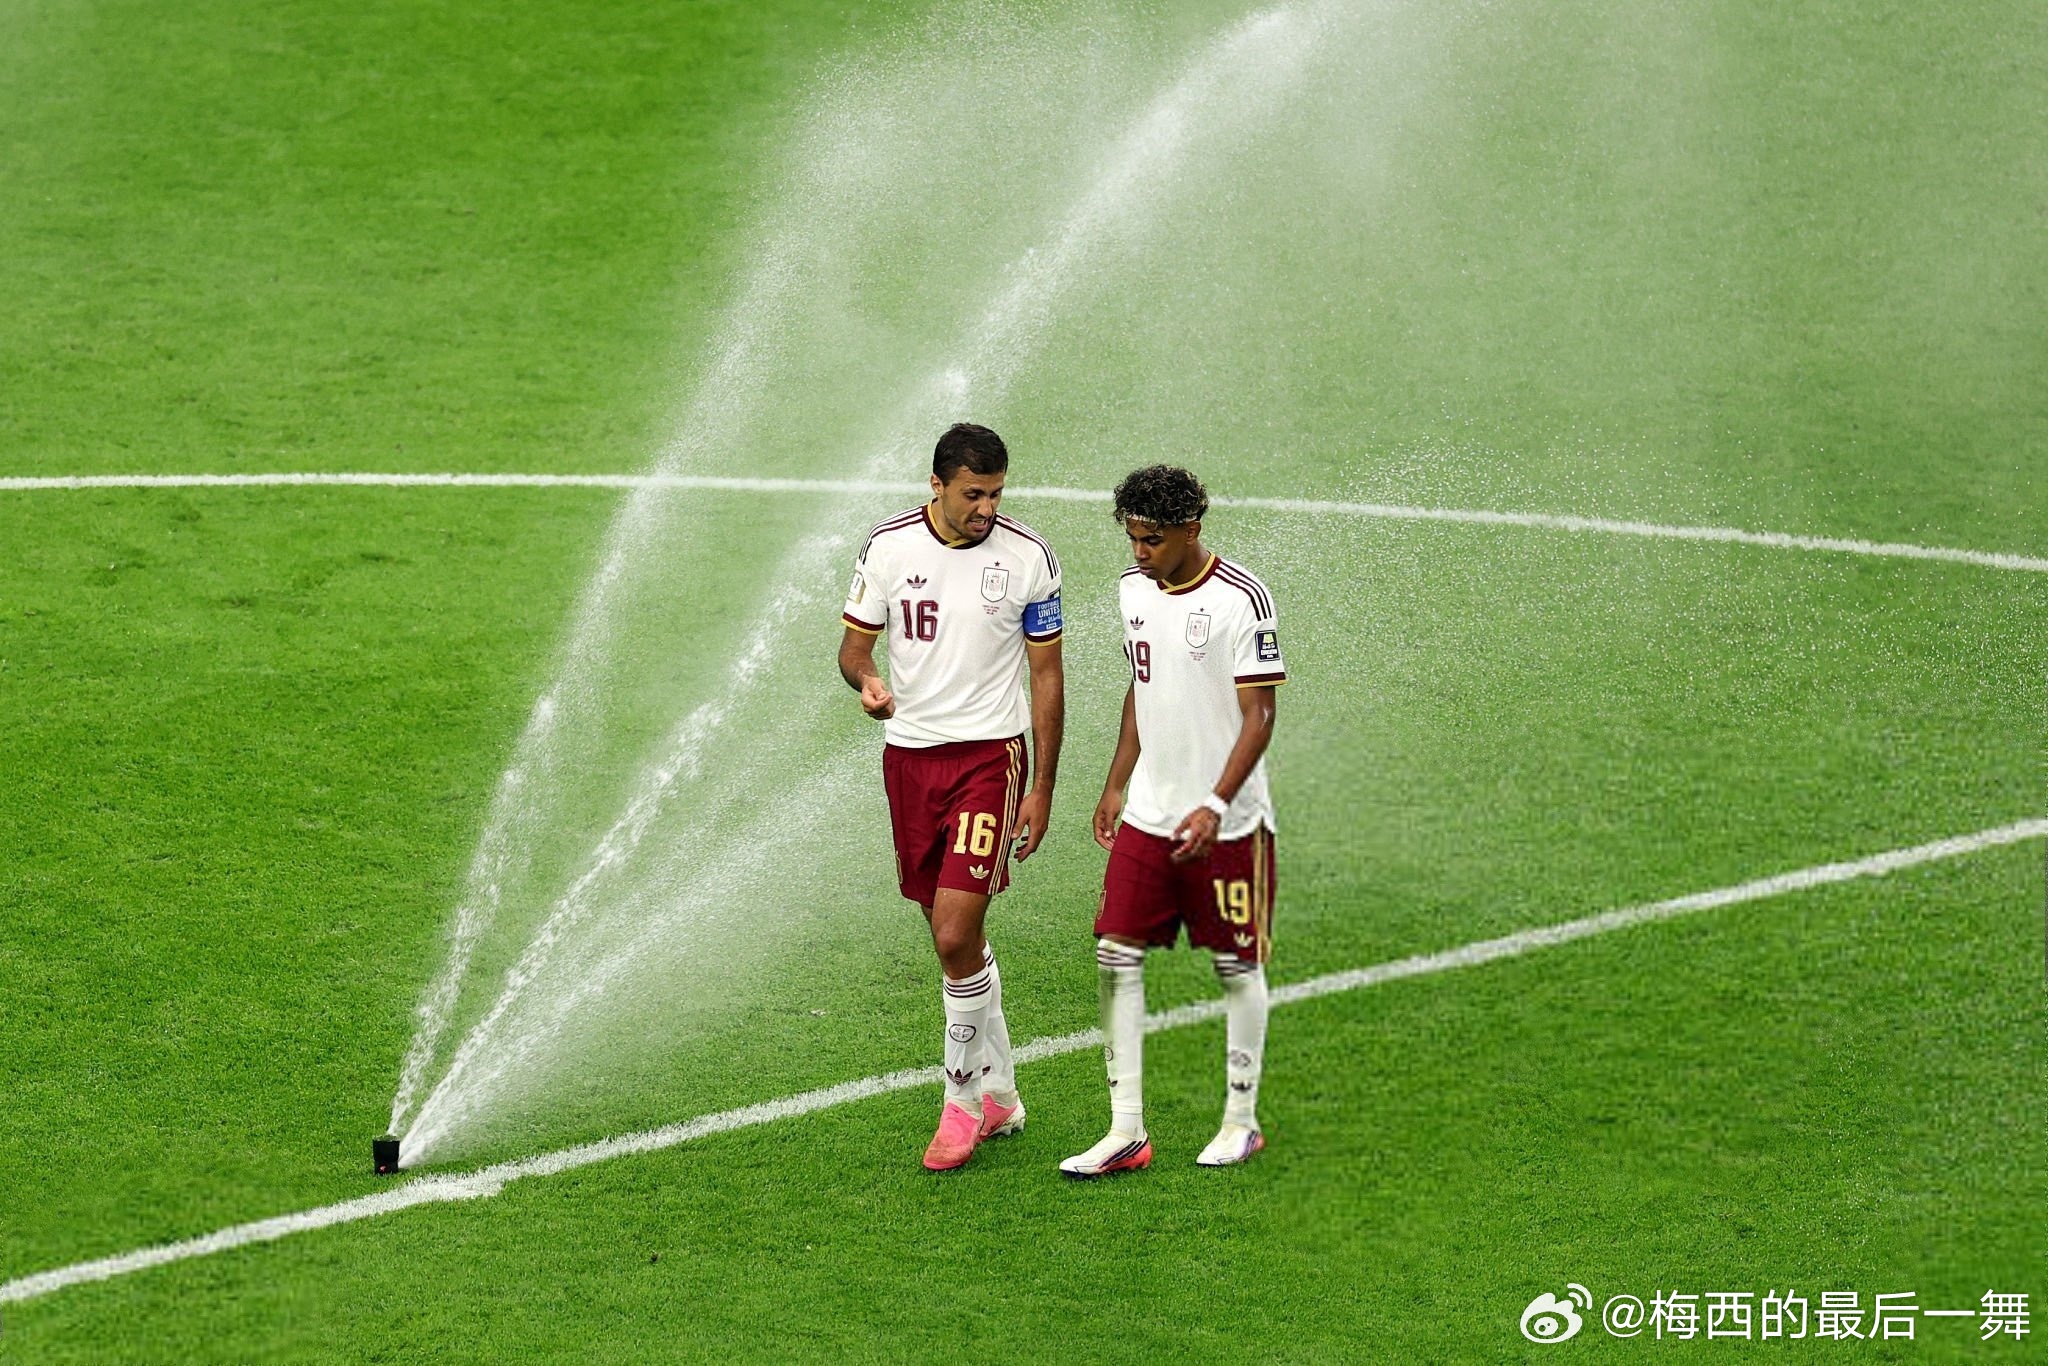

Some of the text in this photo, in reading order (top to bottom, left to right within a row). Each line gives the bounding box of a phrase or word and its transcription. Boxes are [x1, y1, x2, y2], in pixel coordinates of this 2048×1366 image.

[900, 599, 939, 642] 16
[1037, 605, 1060, 618] UNITES
[1128, 639, 1151, 684] 19
[952, 811, 997, 858] 16
[1213, 878, 1251, 925] 19
